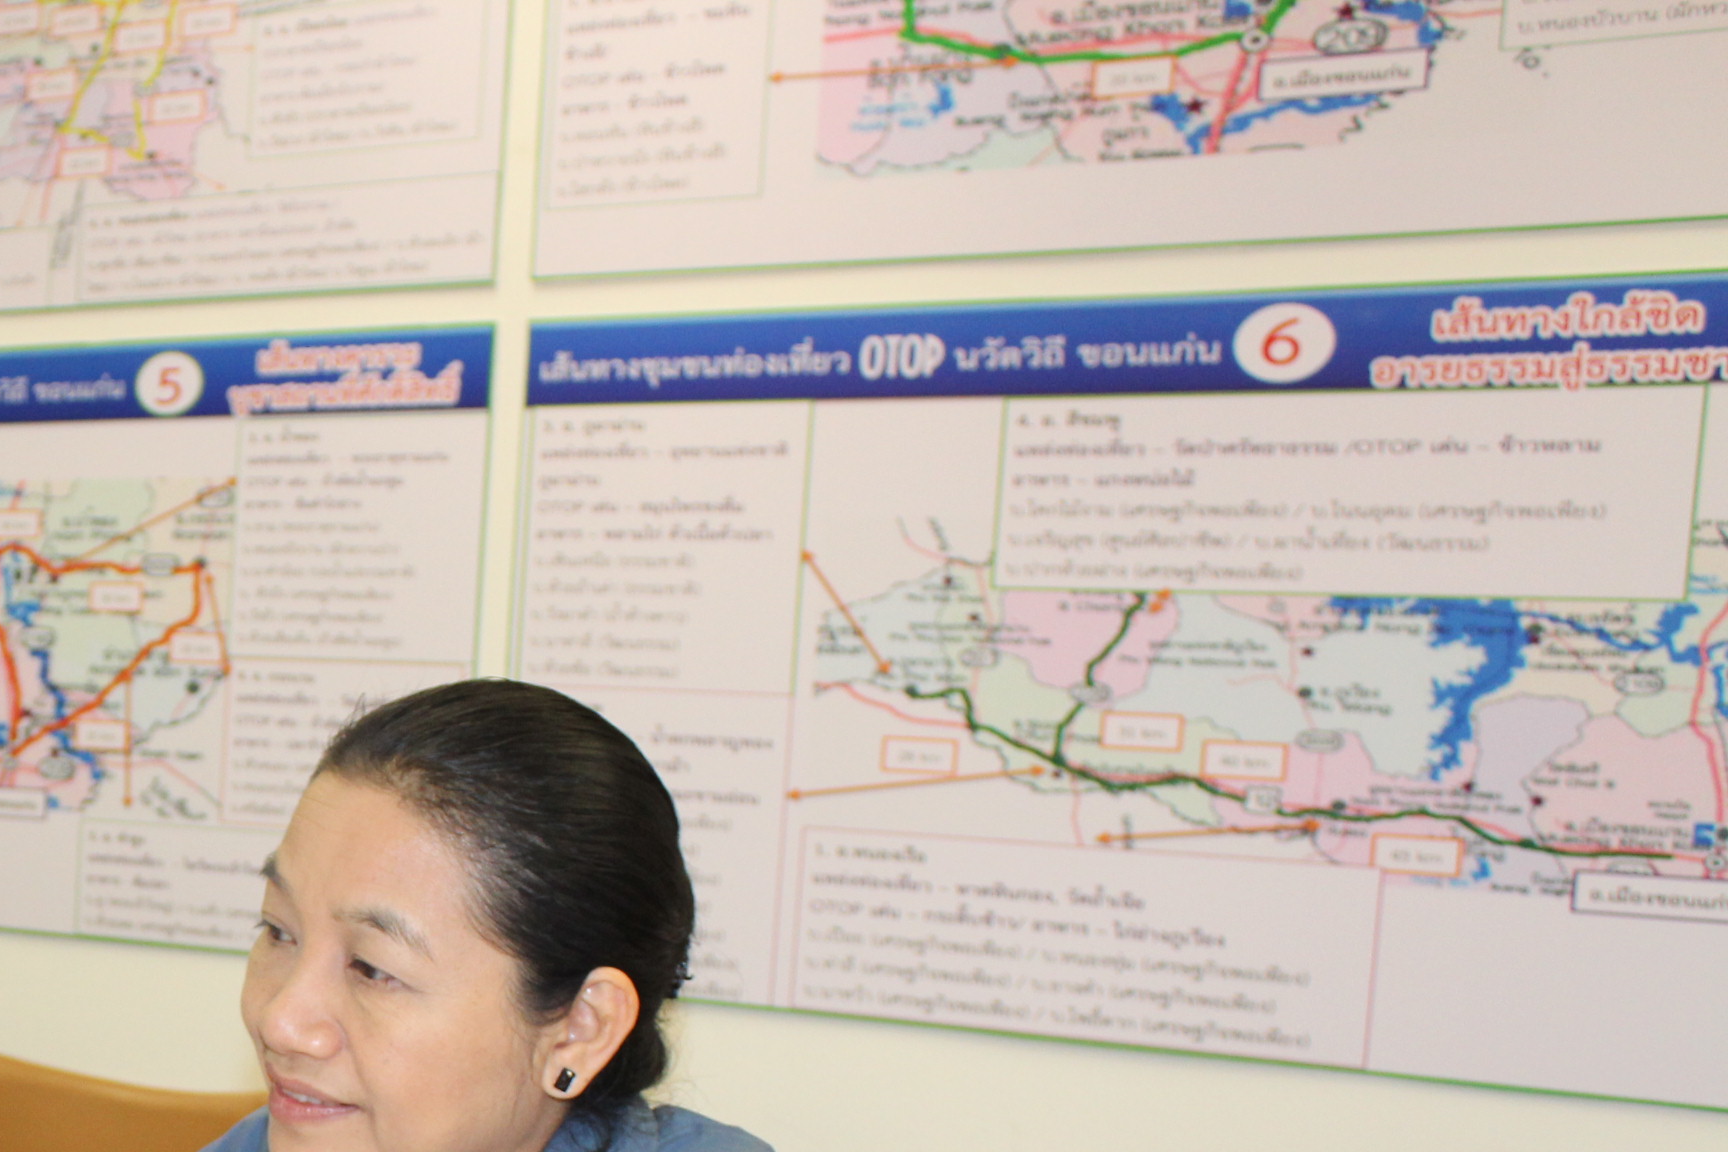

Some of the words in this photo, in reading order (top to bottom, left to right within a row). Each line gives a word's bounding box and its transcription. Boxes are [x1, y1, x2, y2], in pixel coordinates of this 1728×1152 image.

[1432, 290, 1704, 341] เส้นทางใกล้ชิด
[538, 337, 852, 389] เส้นทางชุมชนท่องเที่ยว
[858, 334, 945, 381] OTOP
[1076, 330, 1222, 368] ขอนแก่น
[1260, 316, 1301, 366] 6
[154, 366, 184, 407] 5
